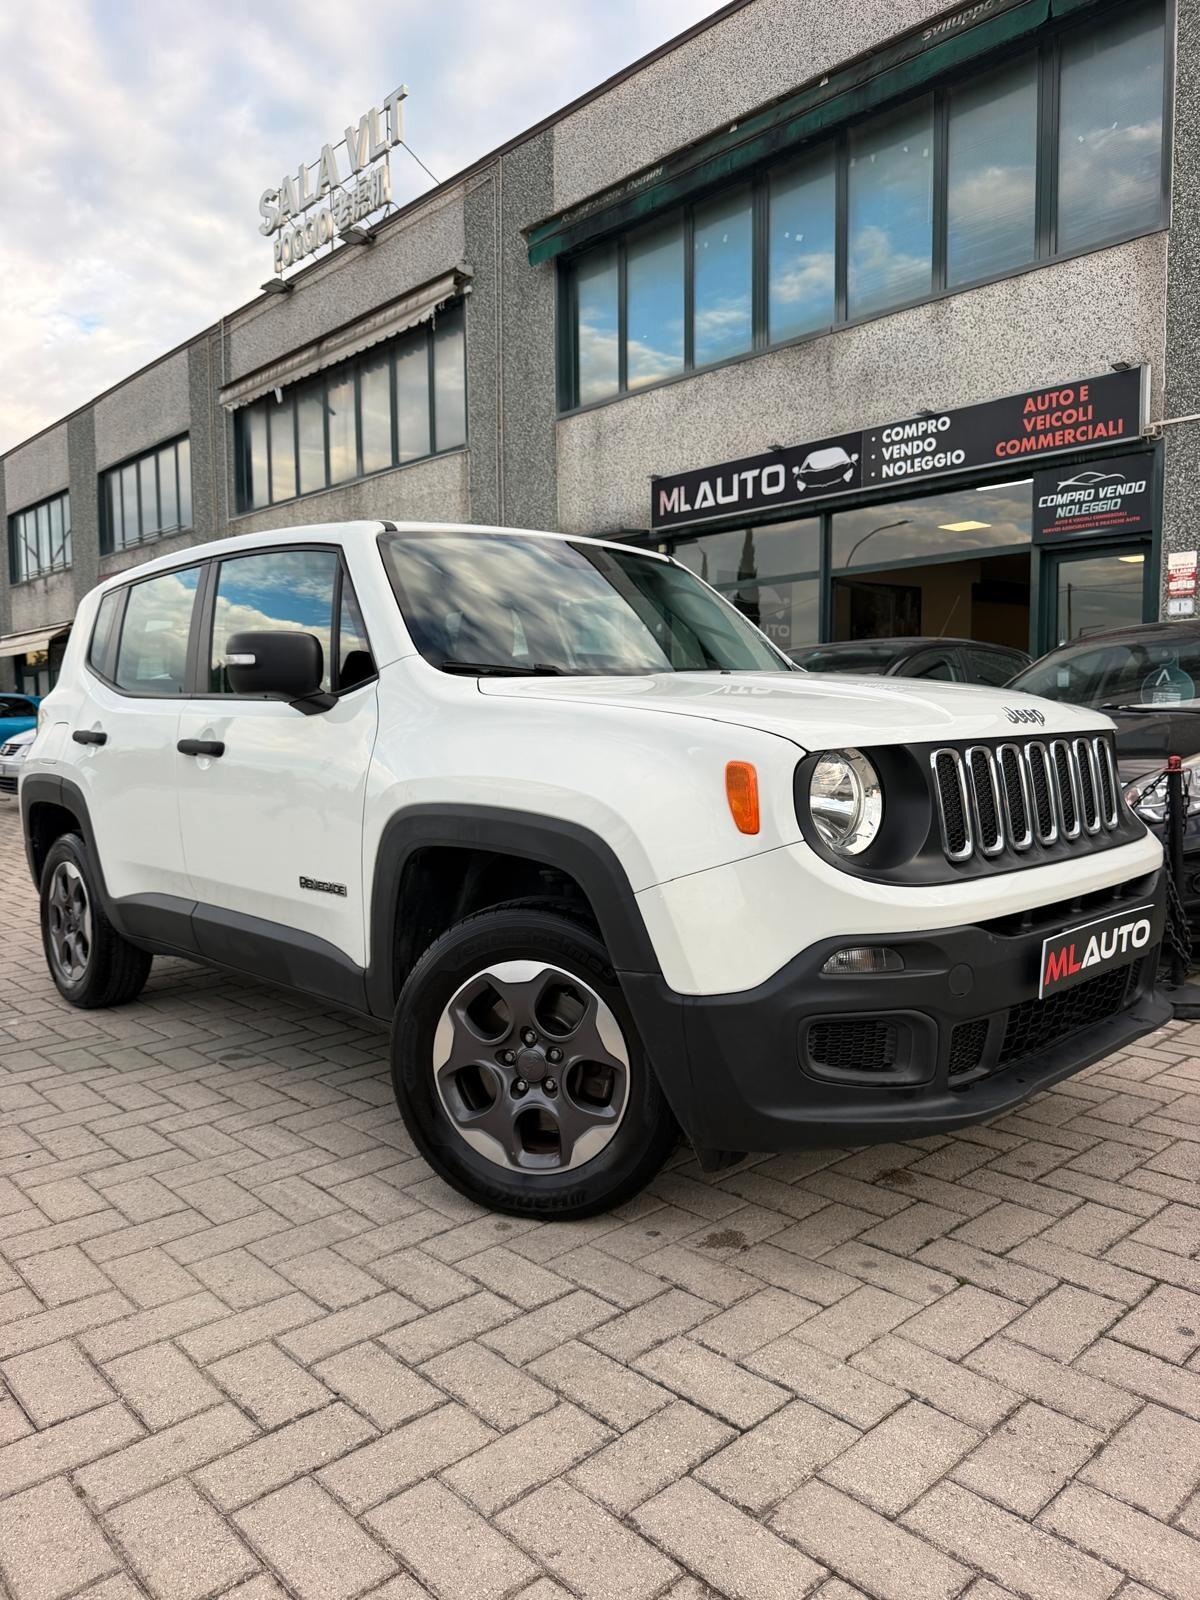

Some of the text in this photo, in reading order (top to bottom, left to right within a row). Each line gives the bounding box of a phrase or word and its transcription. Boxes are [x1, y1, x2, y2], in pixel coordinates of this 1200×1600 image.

[921, 0, 993, 41] Sviluppo
[259, 84, 408, 237] SALA VLT
[273, 207, 335, 273] POGGIO
[1023, 384, 1090, 414] AUTO E
[881, 415, 951, 444] COMPRO
[1023, 405, 1094, 433] VEICOLI
[881, 436, 937, 461] VENDO
[995, 418, 1124, 458] COMMERCIALI
[881, 449, 966, 479] NOLEGGIO
[1038, 480, 1147, 508] COMPRO VENDO
[1055, 498, 1121, 519] NOLEGGIO
[1001, 706, 1045, 727] Jeep
[299, 876, 347, 897] RENEGADE
